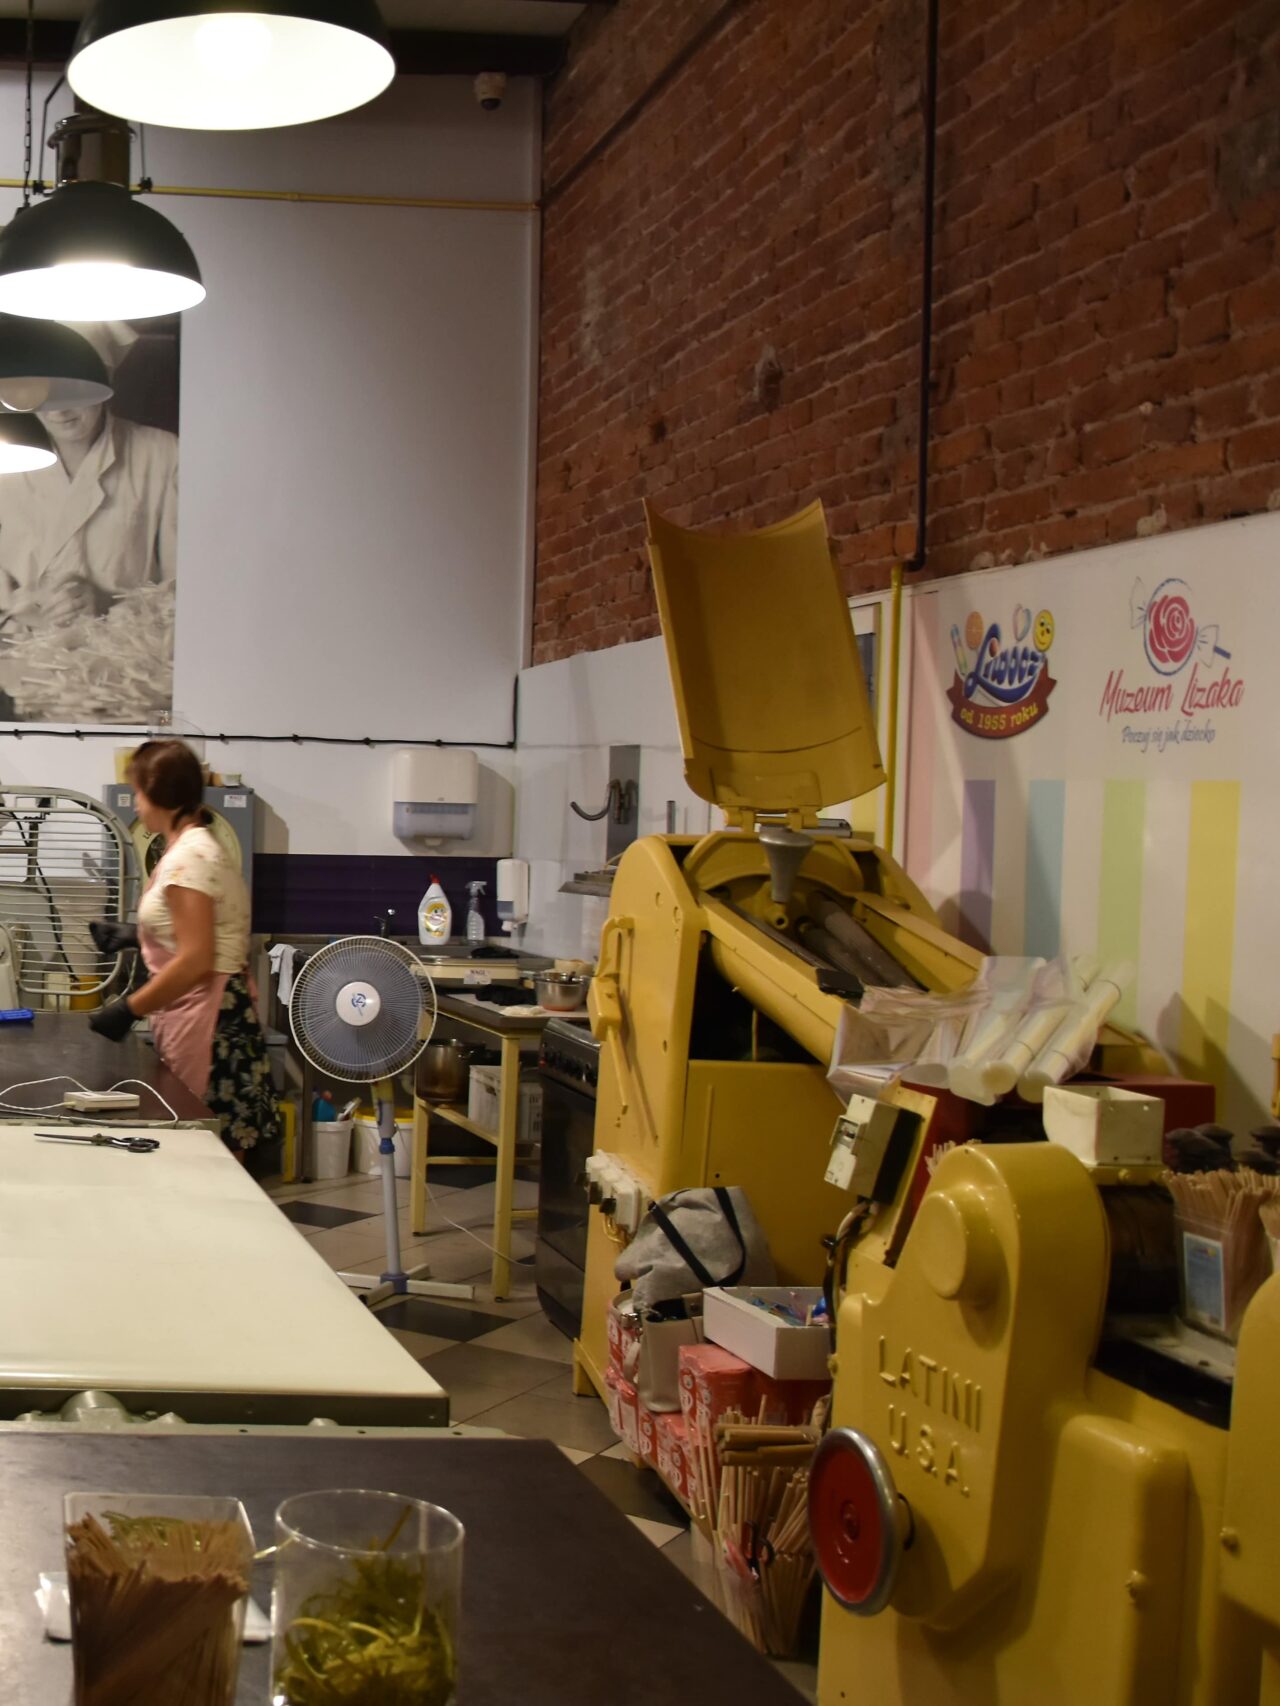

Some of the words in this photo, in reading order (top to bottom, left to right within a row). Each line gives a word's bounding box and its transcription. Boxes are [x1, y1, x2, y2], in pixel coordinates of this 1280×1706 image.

[960, 707, 975, 725] od
[977, 712, 1007, 730] 1955
[1010, 702, 1039, 728] roku
[1098, 669, 1173, 723] Muzeum
[1181, 661, 1245, 717] Lizaka
[878, 1335, 982, 1433] LATINI
[888, 1404, 970, 1498] U.S.A.
